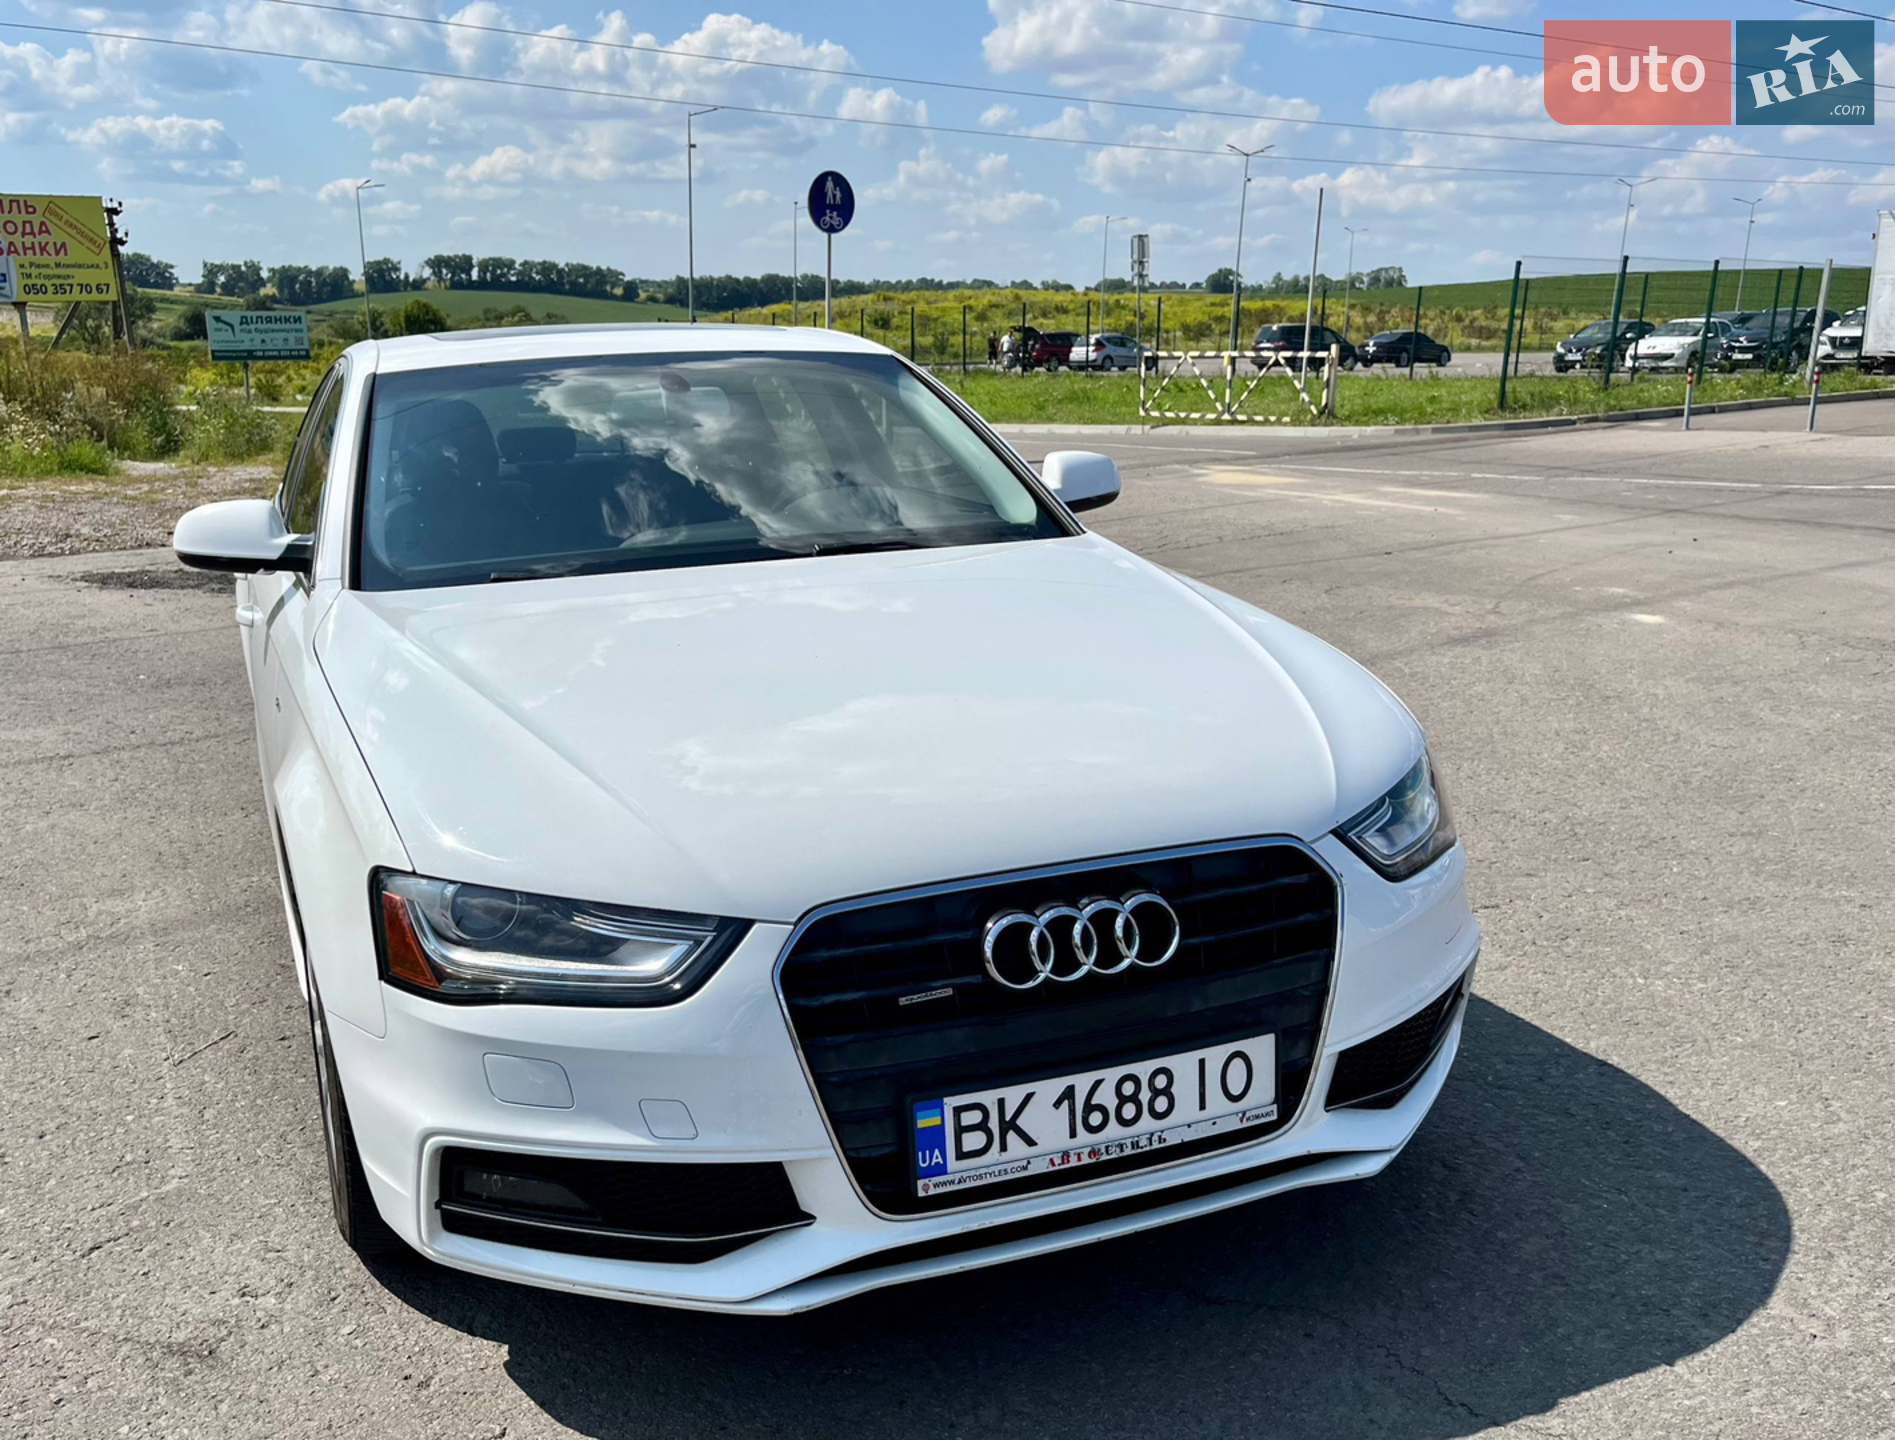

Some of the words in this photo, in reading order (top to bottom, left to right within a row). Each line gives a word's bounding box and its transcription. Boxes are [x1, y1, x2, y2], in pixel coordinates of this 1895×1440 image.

[0, 220, 52, 239] ОДА
[21, 272, 33, 280] ТМ
[23, 283, 48, 296] 050
[51, 283, 75, 296] 357
[76, 283, 93, 295] 70
[96, 282, 111, 295] 67
[239, 315, 303, 326] ДІЛЯНКИ
[952, 1091, 1039, 1162] BK
[1051, 1065, 1175, 1140] 1688
[1198, 1050, 1253, 1112] IO
[918, 1147, 944, 1169] UA
[932, 1162, 1029, 1190] WWW.AVTOSTYLES.COM
